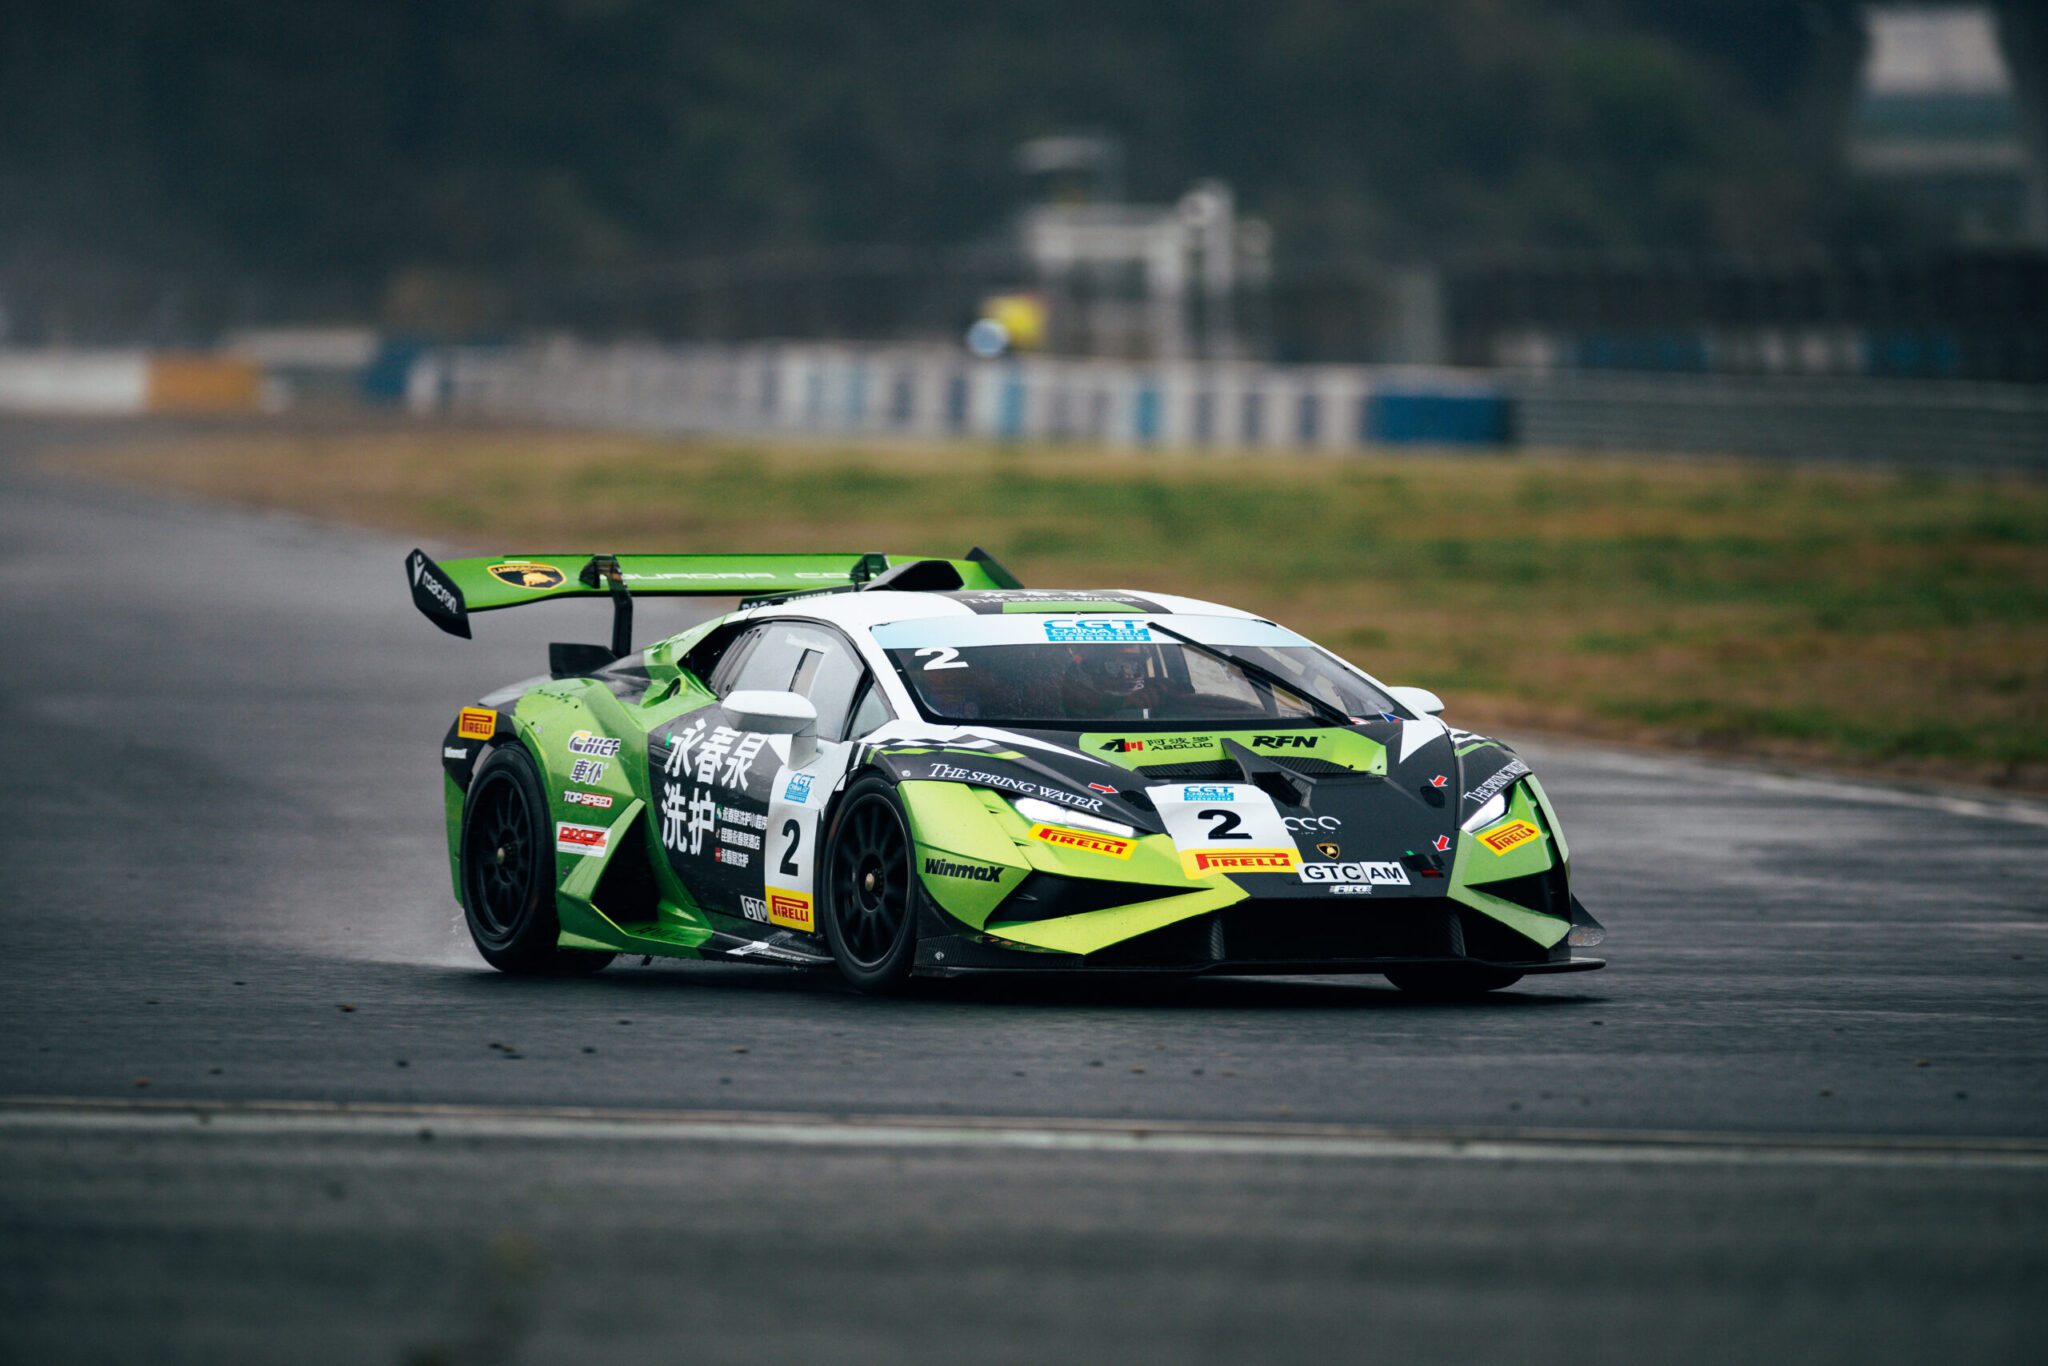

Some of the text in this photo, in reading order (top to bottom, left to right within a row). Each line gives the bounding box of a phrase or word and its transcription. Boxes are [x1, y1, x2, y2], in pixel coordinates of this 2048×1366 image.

[915, 647, 969, 670] 2
[462, 713, 493, 735] PIRELLI
[1252, 736, 1318, 749] RFN
[928, 763, 1103, 812] THE SPRING WATER
[662, 782, 716, 856] 洗护
[1198, 809, 1252, 840] 2
[779, 818, 801, 877] 2
[1039, 828, 1127, 854] PIRELLI
[1485, 823, 1535, 851] PIRELLI
[1195, 852, 1291, 870] PIRELLI
[1304, 865, 1403, 880] GTC AM
[744, 897, 768, 922] GTC
[771, 895, 809, 922] PIRELLI
